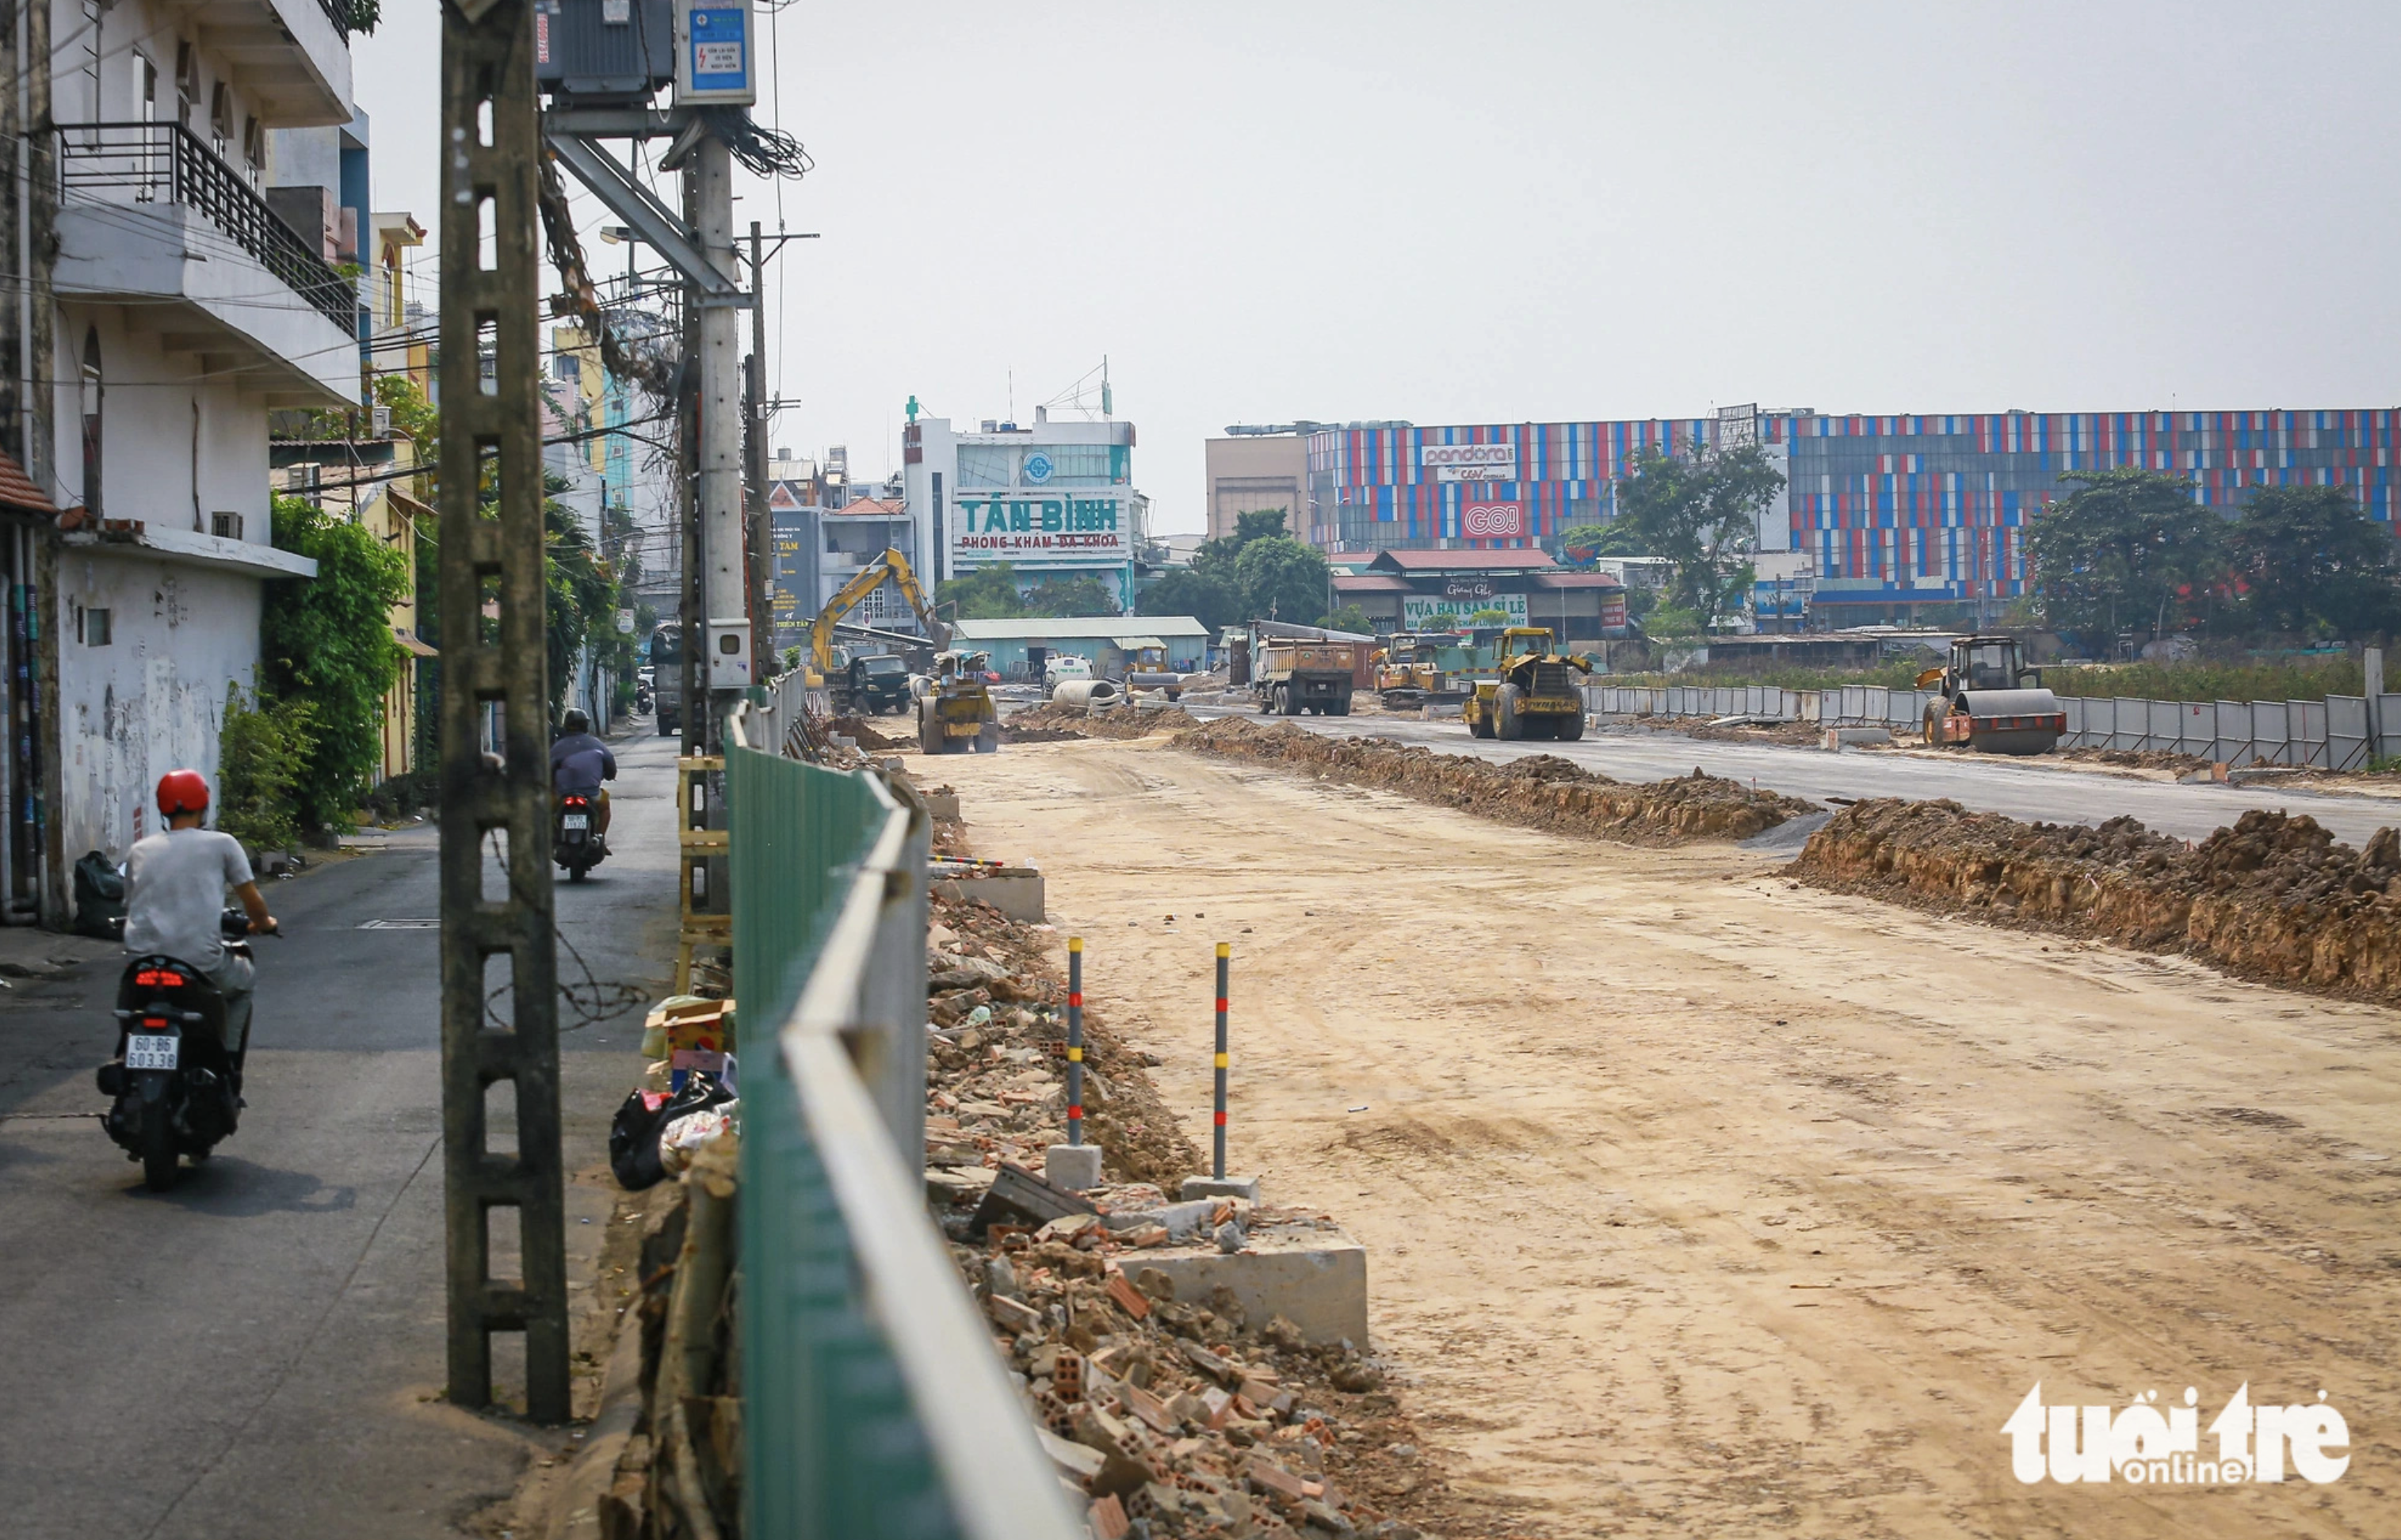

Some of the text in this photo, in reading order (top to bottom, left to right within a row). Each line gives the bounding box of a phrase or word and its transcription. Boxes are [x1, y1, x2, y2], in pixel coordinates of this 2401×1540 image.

[1426, 445, 1506, 465] pandora
[1460, 469, 1483, 479] CGV
[960, 491, 1117, 532] TÂN BÌNH
[1464, 505, 1519, 535] GO!
[961, 532, 1119, 548] PHÒNG KHÁM ĐA KHOA
[136, 1037, 171, 1052] 60-B6
